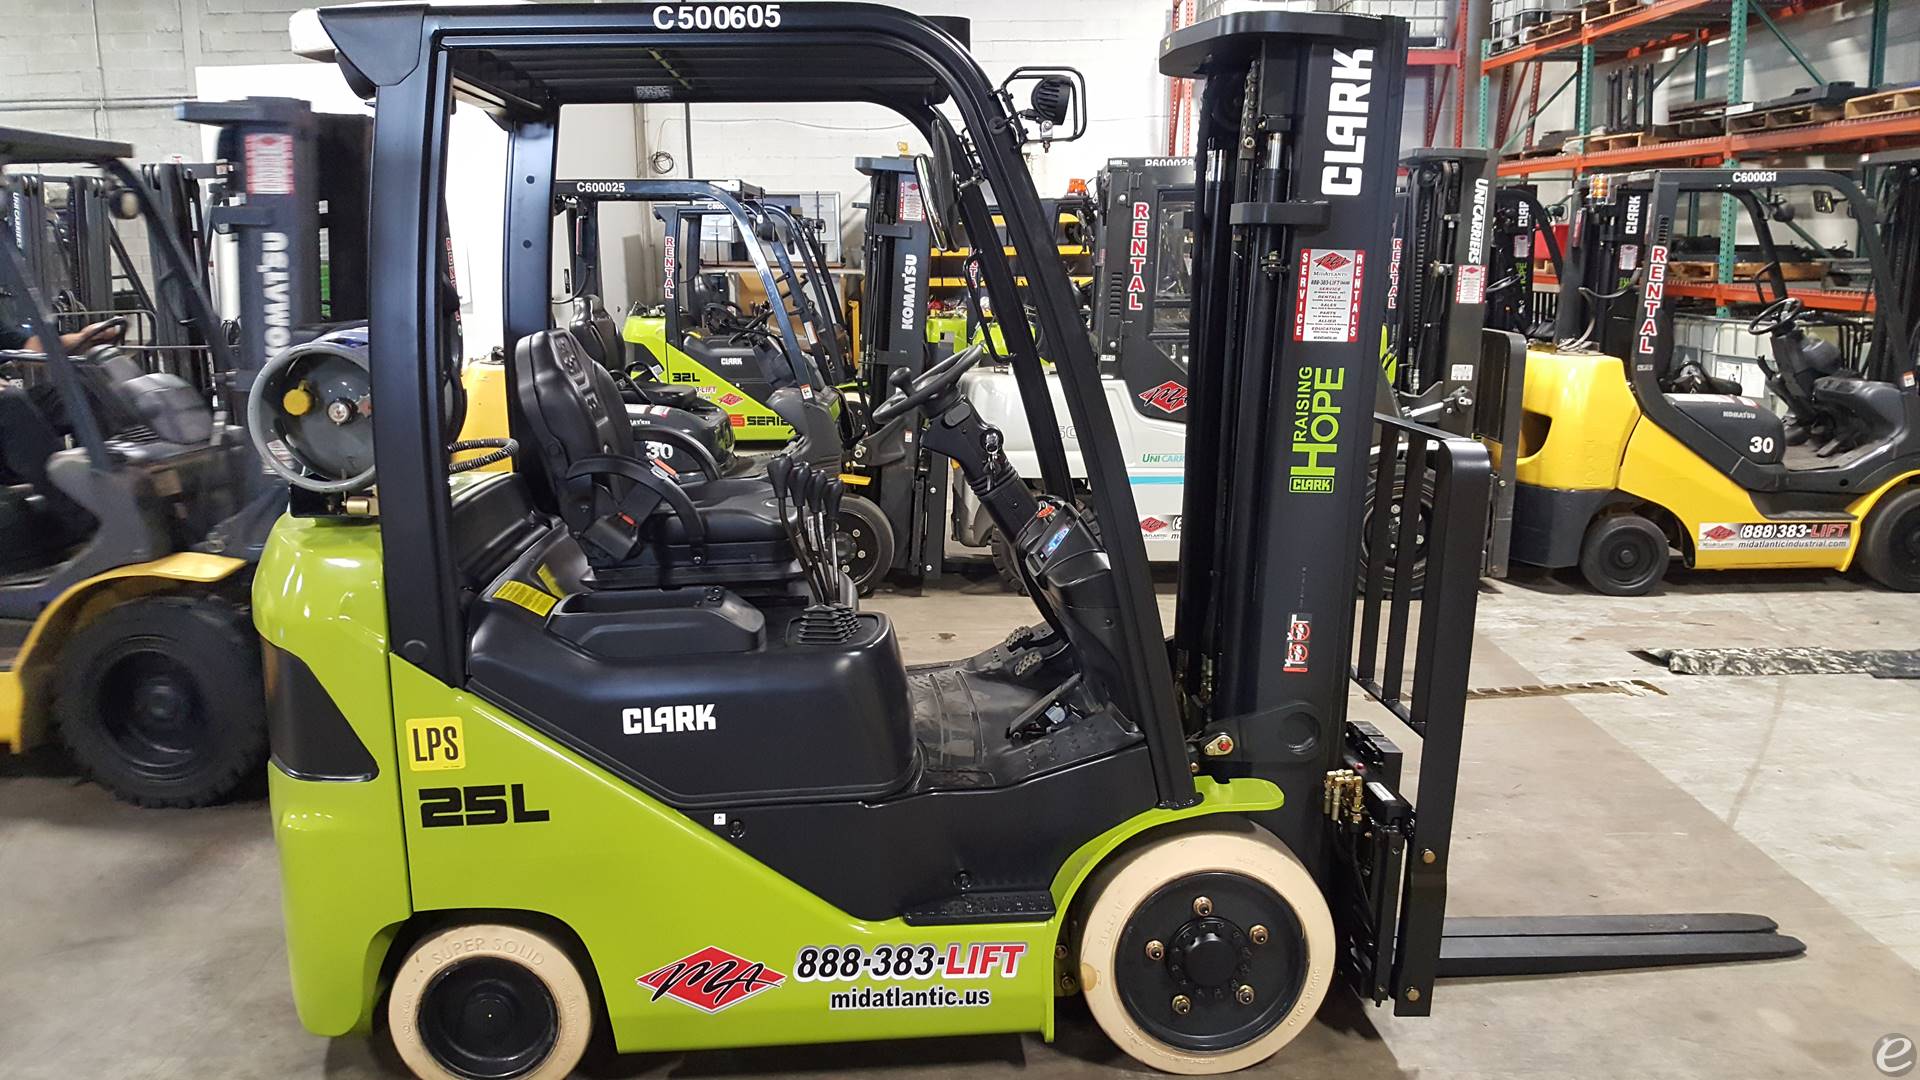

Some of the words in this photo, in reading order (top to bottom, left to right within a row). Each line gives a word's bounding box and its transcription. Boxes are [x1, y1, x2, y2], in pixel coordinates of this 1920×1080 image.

[653, 4, 781, 30] C500605
[1320, 48, 1374, 196] CLARK
[577, 182, 626, 193] C600025
[1732, 171, 1777, 182] C600031
[1468, 178, 1488, 265] UNICARRIERS
[1625, 196, 1641, 235] CLARK
[664, 236, 675, 299] RENTAL
[1128, 202, 1150, 311] RENTAL
[1387, 238, 1403, 310] RENTAL
[901, 254, 918, 330] KOMATSU
[1295, 252, 1309, 336] SERVICE
[1349, 253, 1364, 337] RENTALS
[1639, 245, 1668, 354] RENTAL
[672, 372, 701, 382] 32L
[721, 357, 742, 366] CLARK
[1294, 366, 1313, 441] RAISING
[1290, 367, 1345, 476] HOPE
[645, 441, 673, 459] 30
[1749, 436, 1774, 454] 30
[1292, 479, 1331, 491] CLARK
[1738, 539, 1847, 549] midatlanticindustrial.com
[1740, 524, 1848, 539] (888)383-LIFT
[622, 704, 717, 735] CLARK
[412, 726, 459, 761] LPS
[418, 783, 550, 828] 25L
[432, 938, 485, 965] SUPER
[494, 939, 545, 966] SOLID
[830, 986, 991, 1009] midatlantic.us
